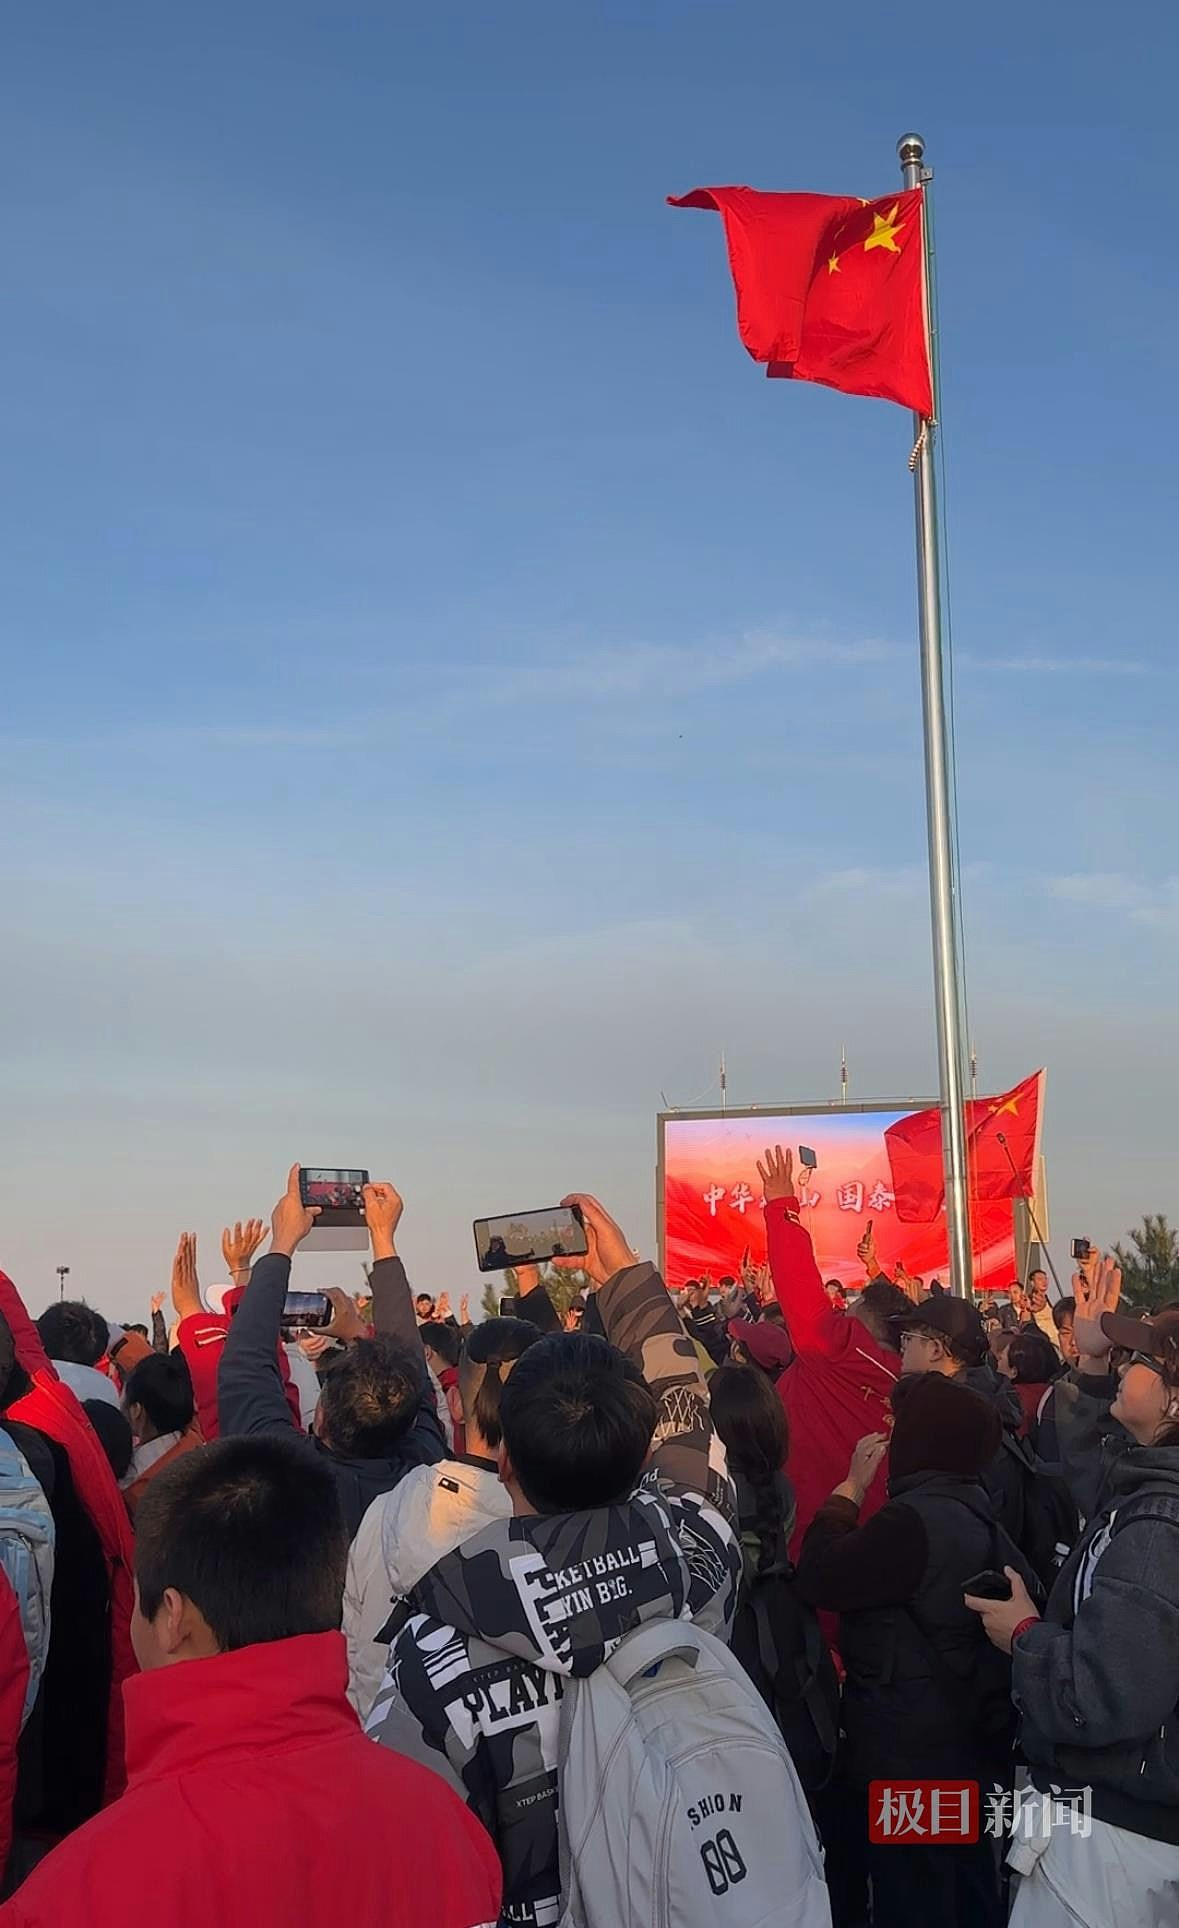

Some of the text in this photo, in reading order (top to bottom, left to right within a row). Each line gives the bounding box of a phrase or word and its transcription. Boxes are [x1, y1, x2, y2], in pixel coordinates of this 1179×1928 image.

[703, 1182, 821, 1216] 中华山
[687, 1793, 742, 1830] SHION
